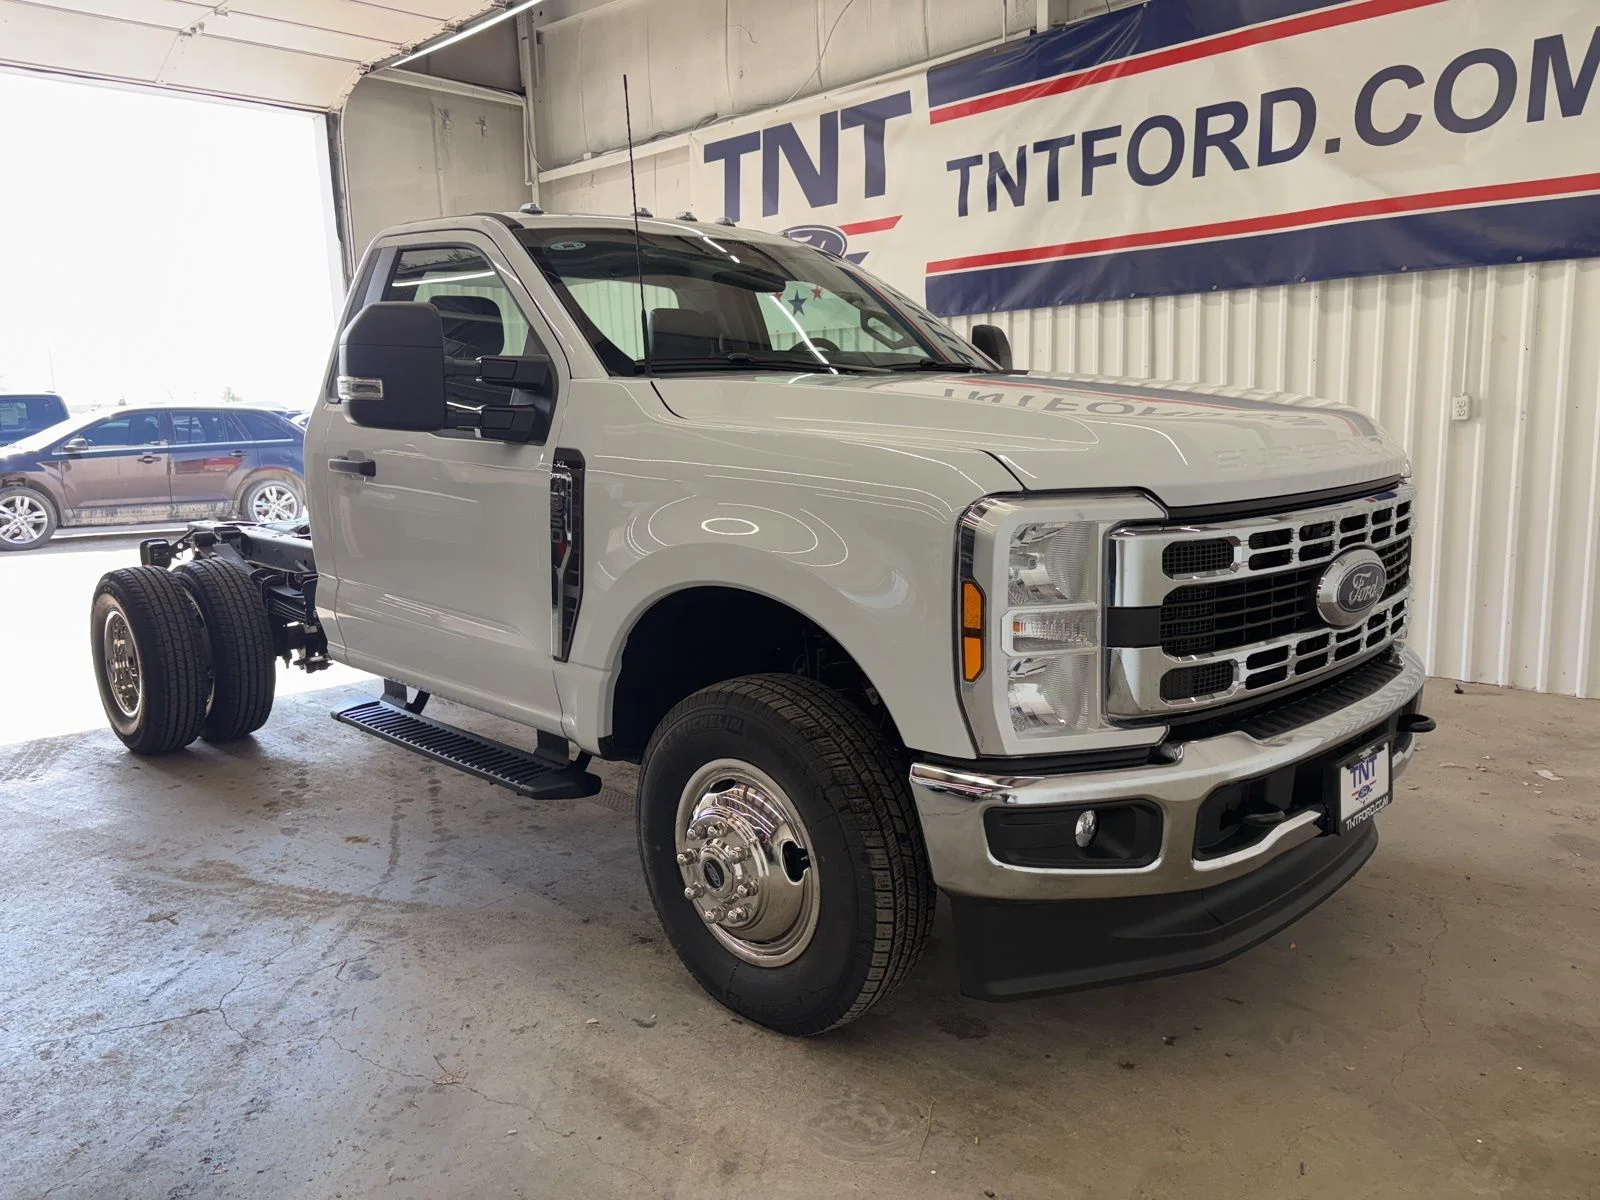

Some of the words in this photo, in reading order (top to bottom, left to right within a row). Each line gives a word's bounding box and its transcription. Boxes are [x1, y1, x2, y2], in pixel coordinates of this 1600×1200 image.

[704, 90, 912, 223] TNT
[946, 25, 1600, 217] TNTFORD.COM
[1349, 571, 1379, 606] Ford
[1350, 754, 1378, 788] TNT
